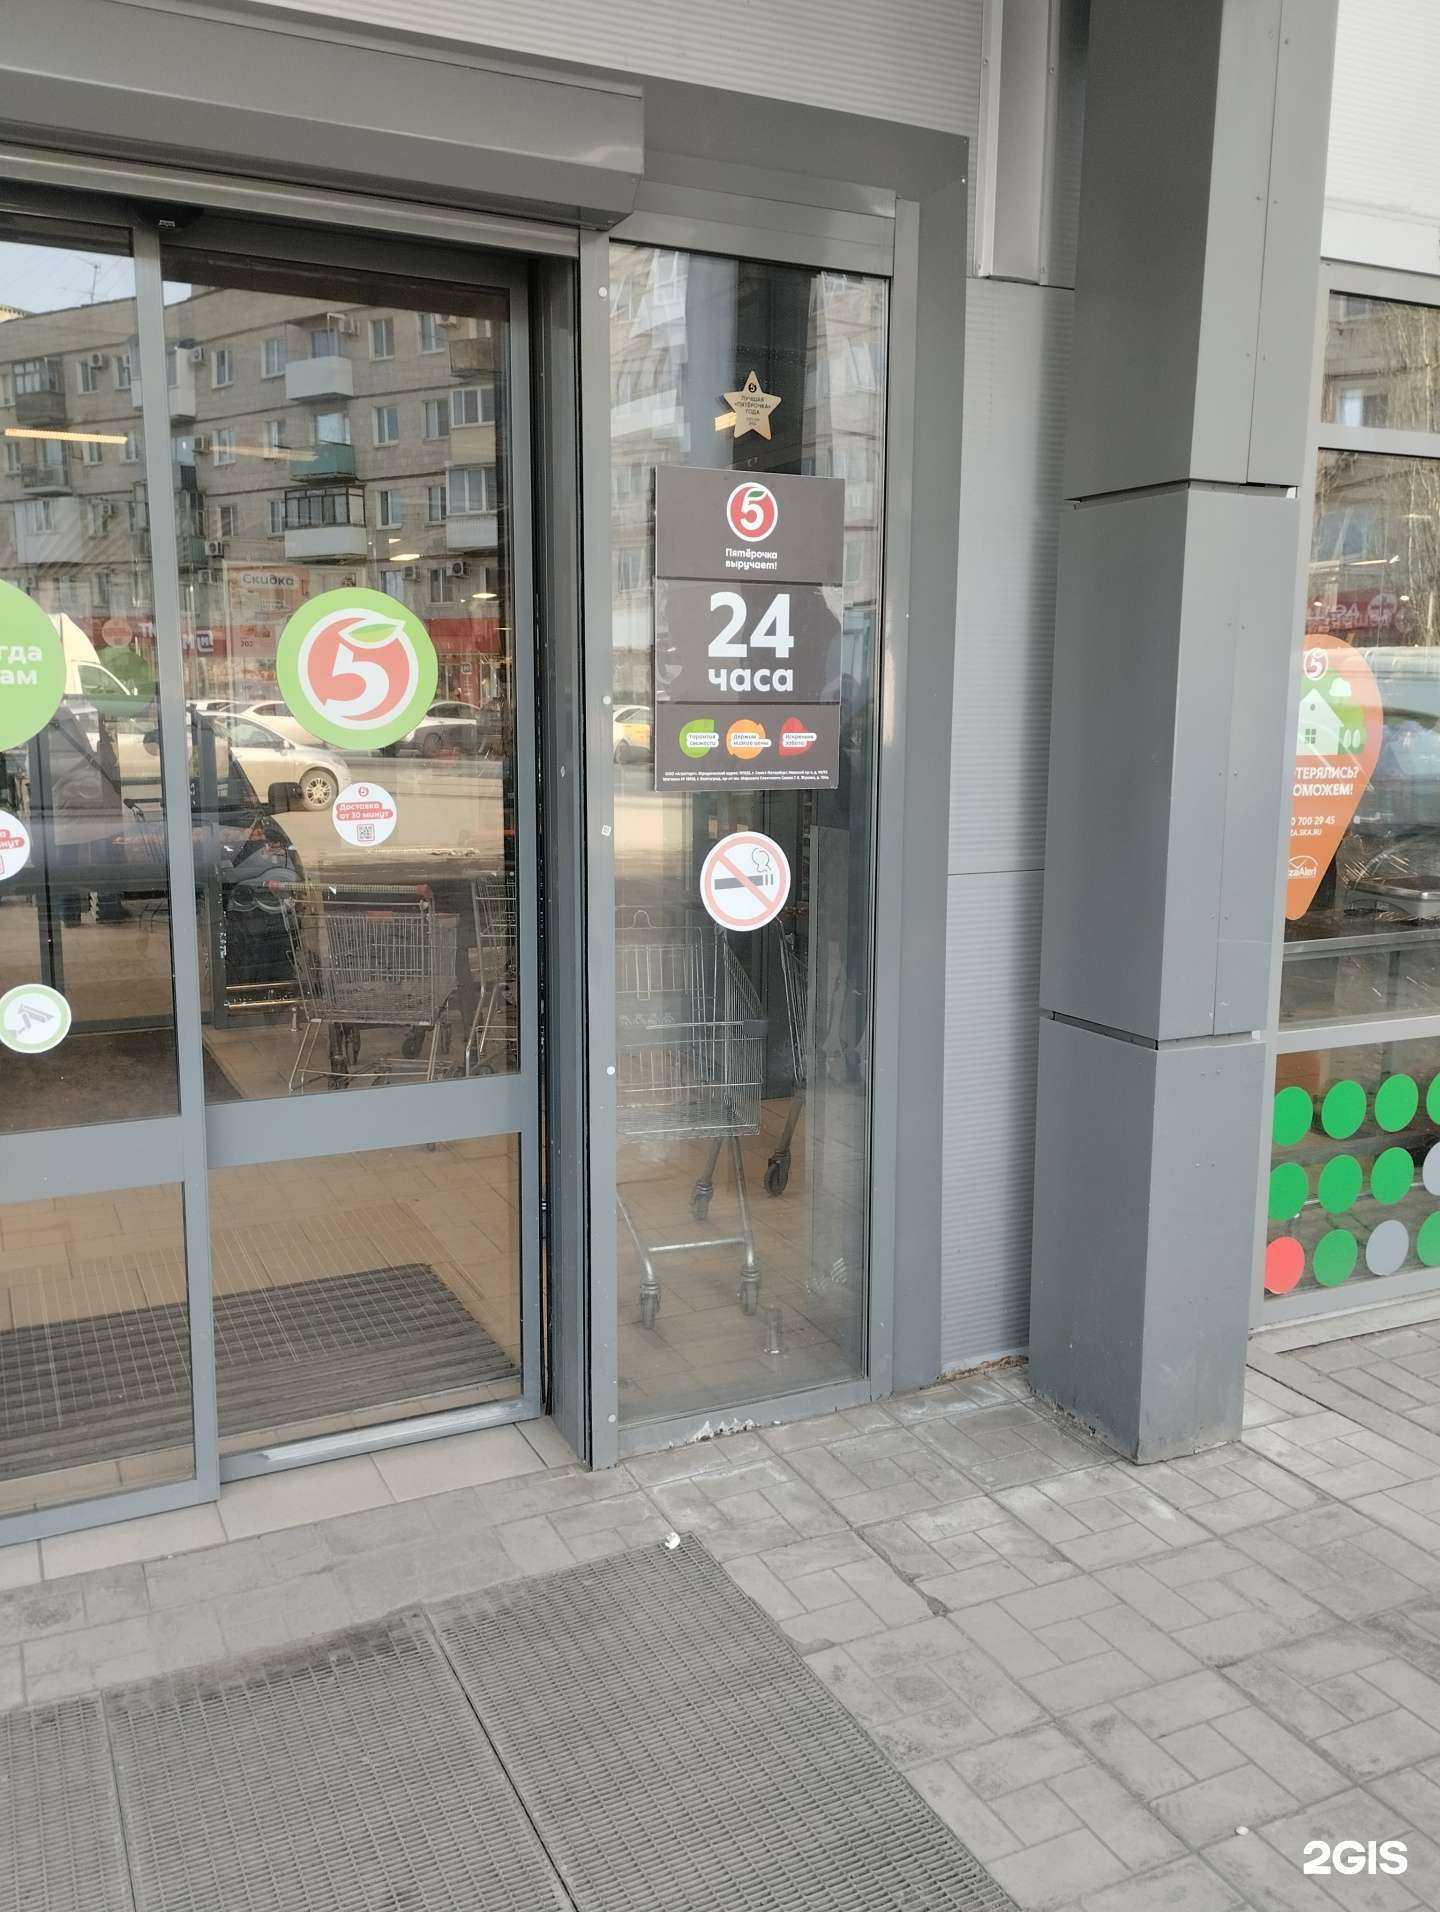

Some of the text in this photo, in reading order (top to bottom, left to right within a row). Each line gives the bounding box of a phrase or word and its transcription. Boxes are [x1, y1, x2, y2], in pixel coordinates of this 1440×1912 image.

[725, 548, 778, 560] Пятёрочка
[725, 560, 778, 570] выручает!
[242, 574, 295, 586] Скидка
[708, 591, 795, 658] 24
[708, 668, 794, 692] часа
[1294, 766, 1360, 779] ТЕРЯЛИСЬ?
[1292, 784, 1354, 797] ОМОЖЕМ!
